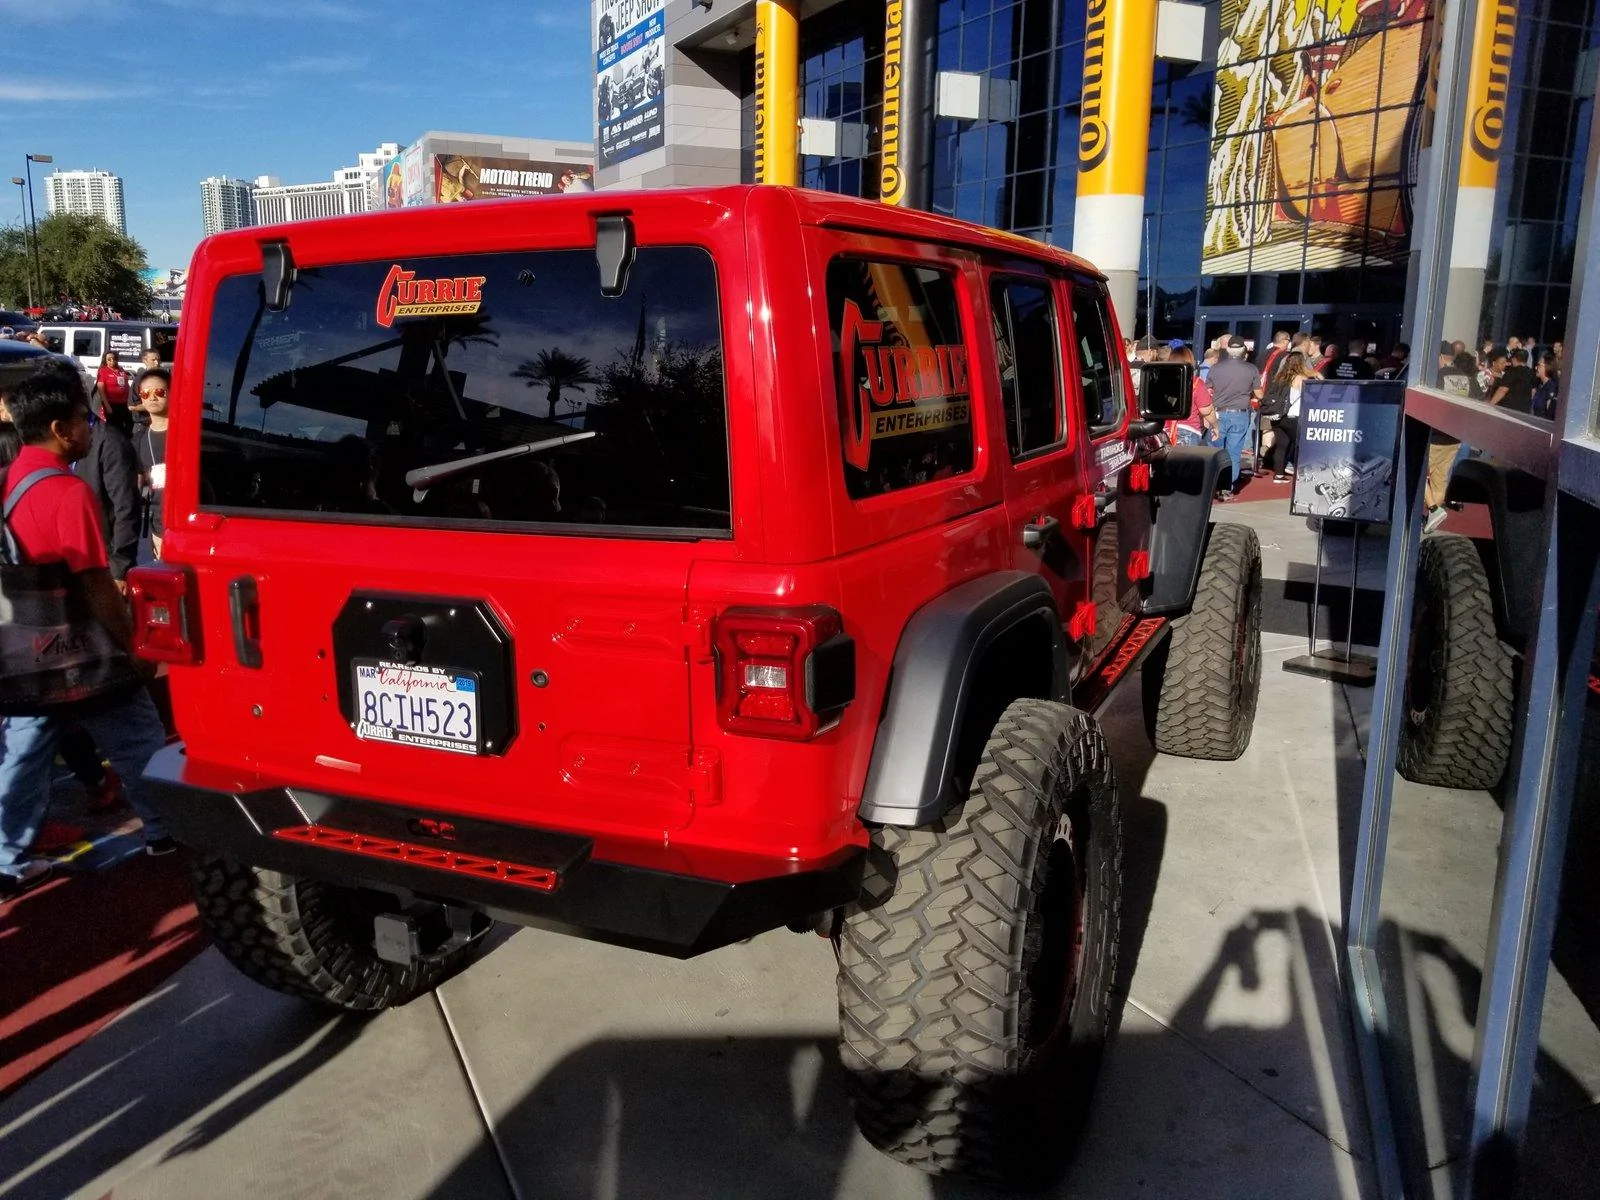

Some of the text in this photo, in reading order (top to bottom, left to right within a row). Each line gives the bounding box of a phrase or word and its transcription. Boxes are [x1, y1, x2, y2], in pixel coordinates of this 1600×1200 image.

[616, 0, 634, 33] JEEP
[637, 0, 660, 19] SH
[376, 264, 483, 328] CURRIE
[398, 304, 477, 314] ENTERPRISES
[840, 297, 969, 472] CURRIE
[875, 405, 968, 434] ENTERPRISES
[1308, 408, 1345, 423] MORE
[1306, 427, 1363, 443] EXHIBITS
[360, 667, 376, 678] MAR
[378, 667, 457, 693] California
[432, 667, 446, 675] BY
[364, 690, 472, 739] 8CIH523
[356, 719, 477, 752] CURRIE ENTERPRISES
